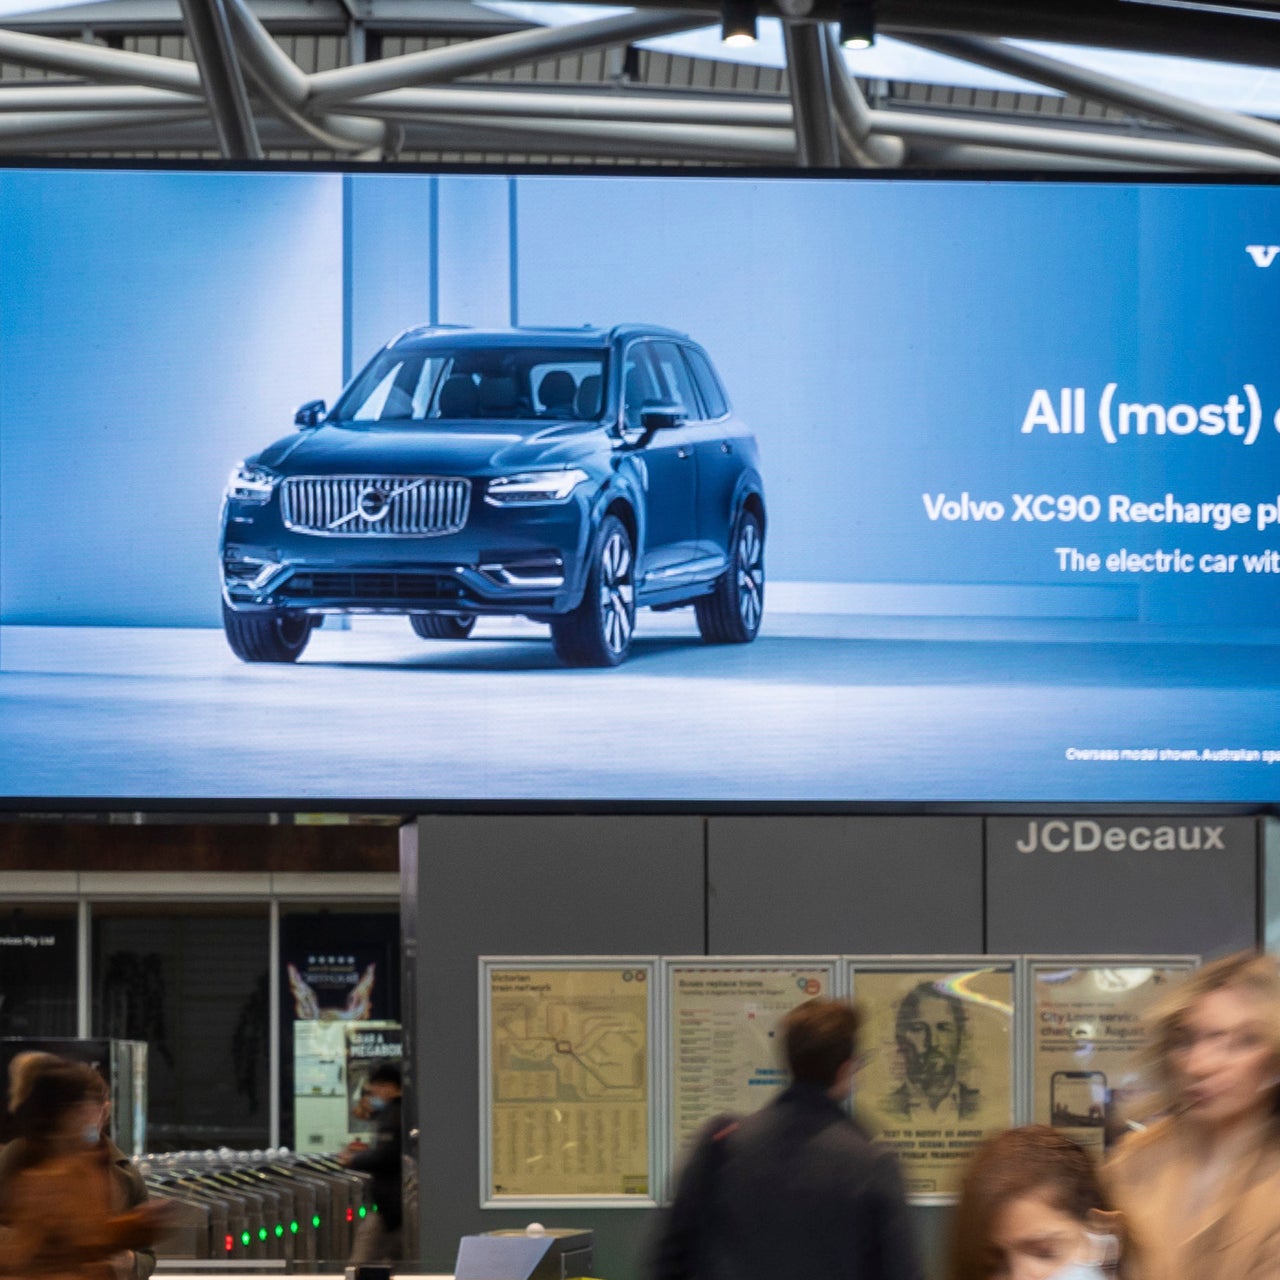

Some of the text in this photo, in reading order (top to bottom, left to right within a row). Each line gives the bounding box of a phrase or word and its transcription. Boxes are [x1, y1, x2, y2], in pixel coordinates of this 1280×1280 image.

[1021, 388, 1085, 434] All
[1099, 383, 1262, 445] (most)
[923, 492, 1005, 522] Volvo
[1011, 494, 1101, 522] XC90
[1109, 494, 1251, 531] Recharge
[1055, 548, 1101, 572] The
[1106, 549, 1194, 573] electric
[1200, 555, 1238, 573] car
[1065, 748, 1120, 761] Overseas
[1016, 820, 1225, 853] JCDecaux
